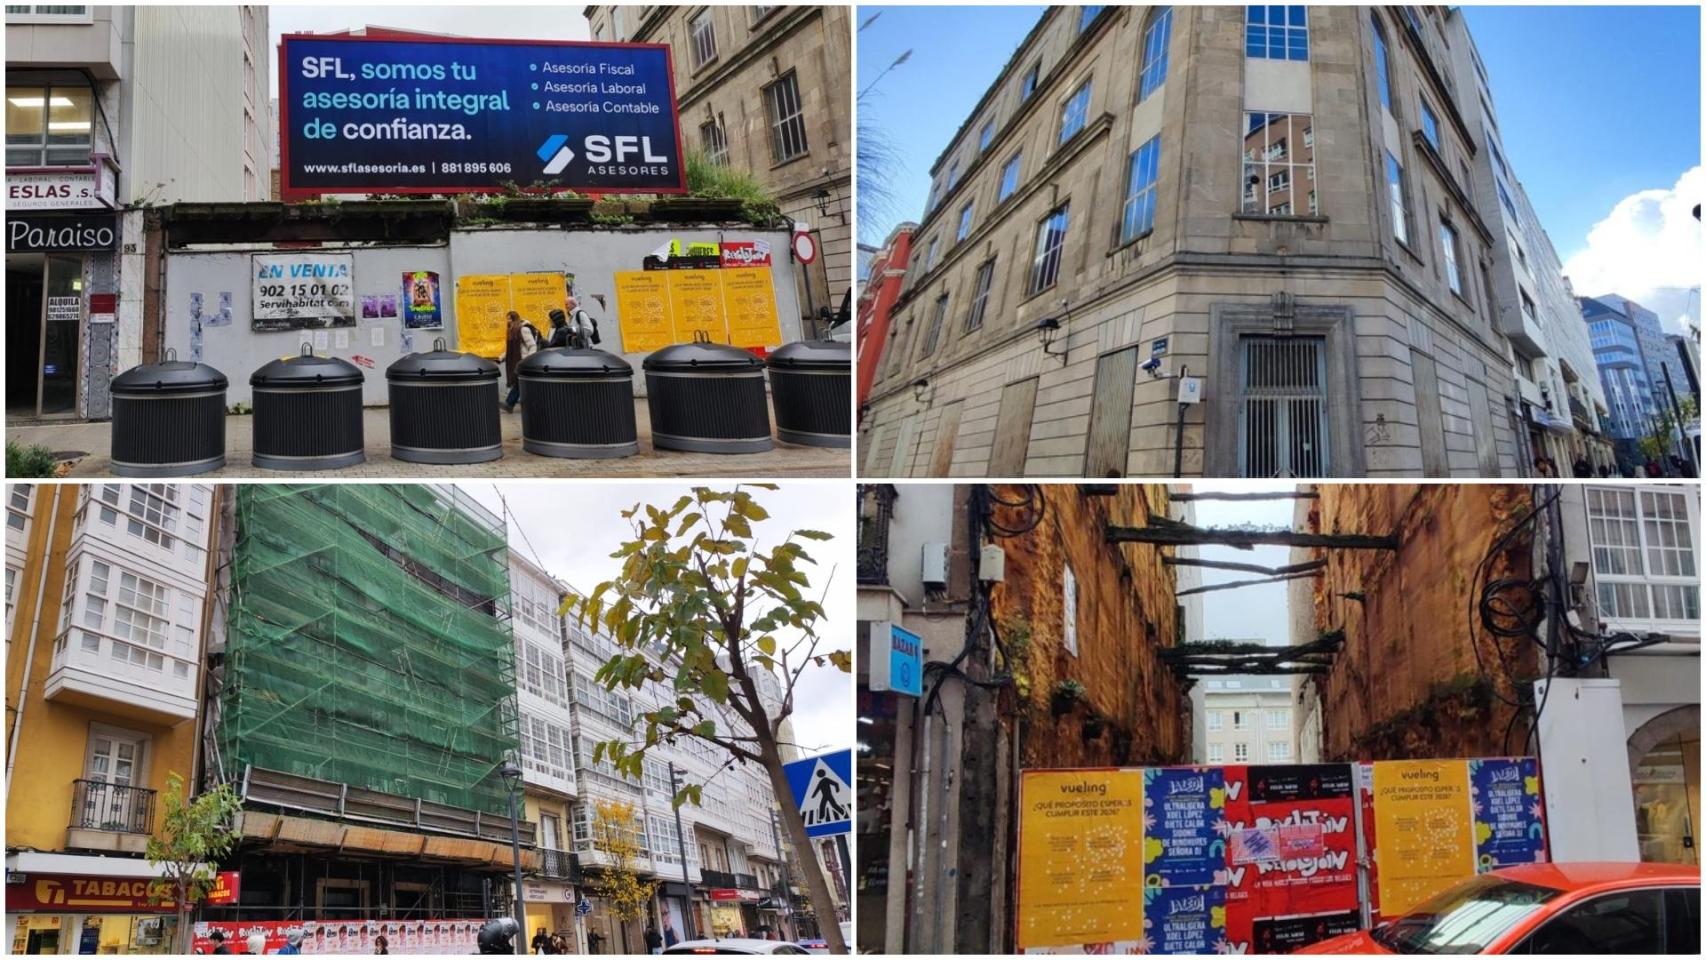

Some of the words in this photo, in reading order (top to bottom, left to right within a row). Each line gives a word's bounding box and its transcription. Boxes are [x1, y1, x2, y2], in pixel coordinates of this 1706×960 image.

[302, 56, 355, 81] SFL,
[361, 62, 446, 80] somos
[451, 61, 476, 80] tu
[600, 63, 634, 75] Fiscal
[601, 82, 646, 94] Laboral
[303, 88, 410, 109] asesoría
[415, 88, 510, 115] integral
[603, 101, 659, 114] Contable
[303, 118, 337, 139] de
[343, 118, 472, 140] confianza.
[584, 134, 668, 163] SFL
[304, 162, 426, 174] www.sflasesoria.es
[489, 163, 512, 174] 606
[588, 166, 669, 176] ASESORES
[9, 185, 71, 199] ESLAS
[8, 221, 114, 250] Paraiso
[124, 243, 137, 253] 93
[259, 265, 283, 278] EN
[290, 263, 349, 278] VENTA
[260, 285, 285, 297] 902
[290, 284, 306, 296] 15
[311, 284, 326, 296] 01
[1401, 768, 1440, 781] vueling
[1060, 781, 1106, 796] vueling
